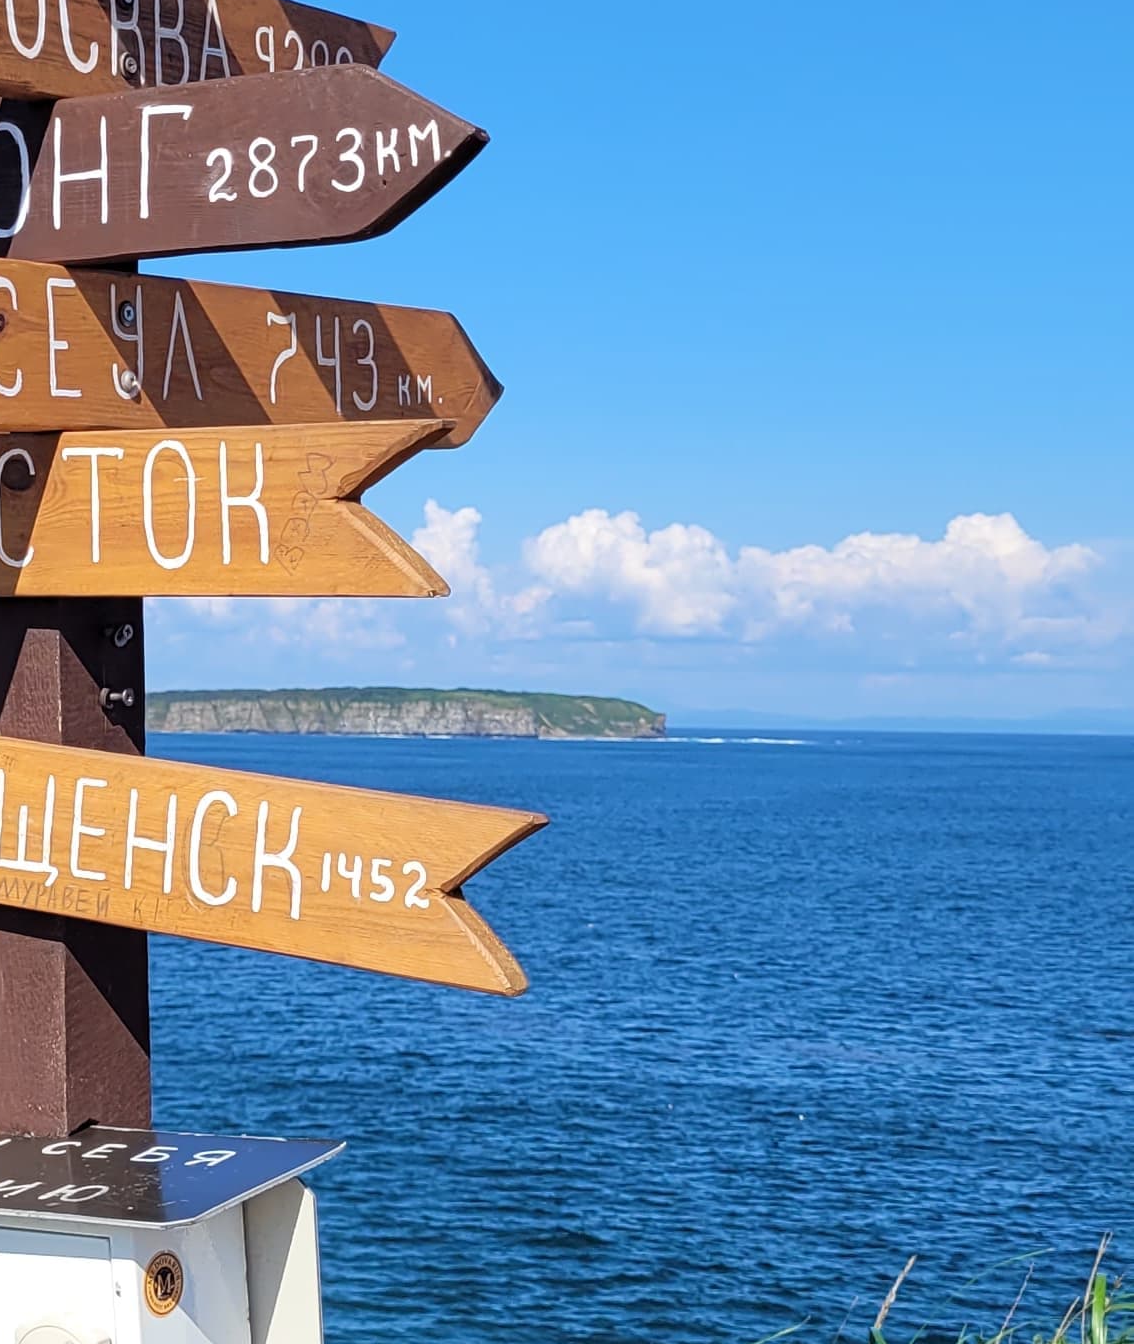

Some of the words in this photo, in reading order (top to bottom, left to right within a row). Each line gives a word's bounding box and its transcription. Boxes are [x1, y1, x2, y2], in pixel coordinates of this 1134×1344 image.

[206, 127, 365, 202] 2873
[267, 311, 379, 416] 743
[321, 852, 430, 909] 1452
[41, 1140, 237, 1168] СЕБЯ
